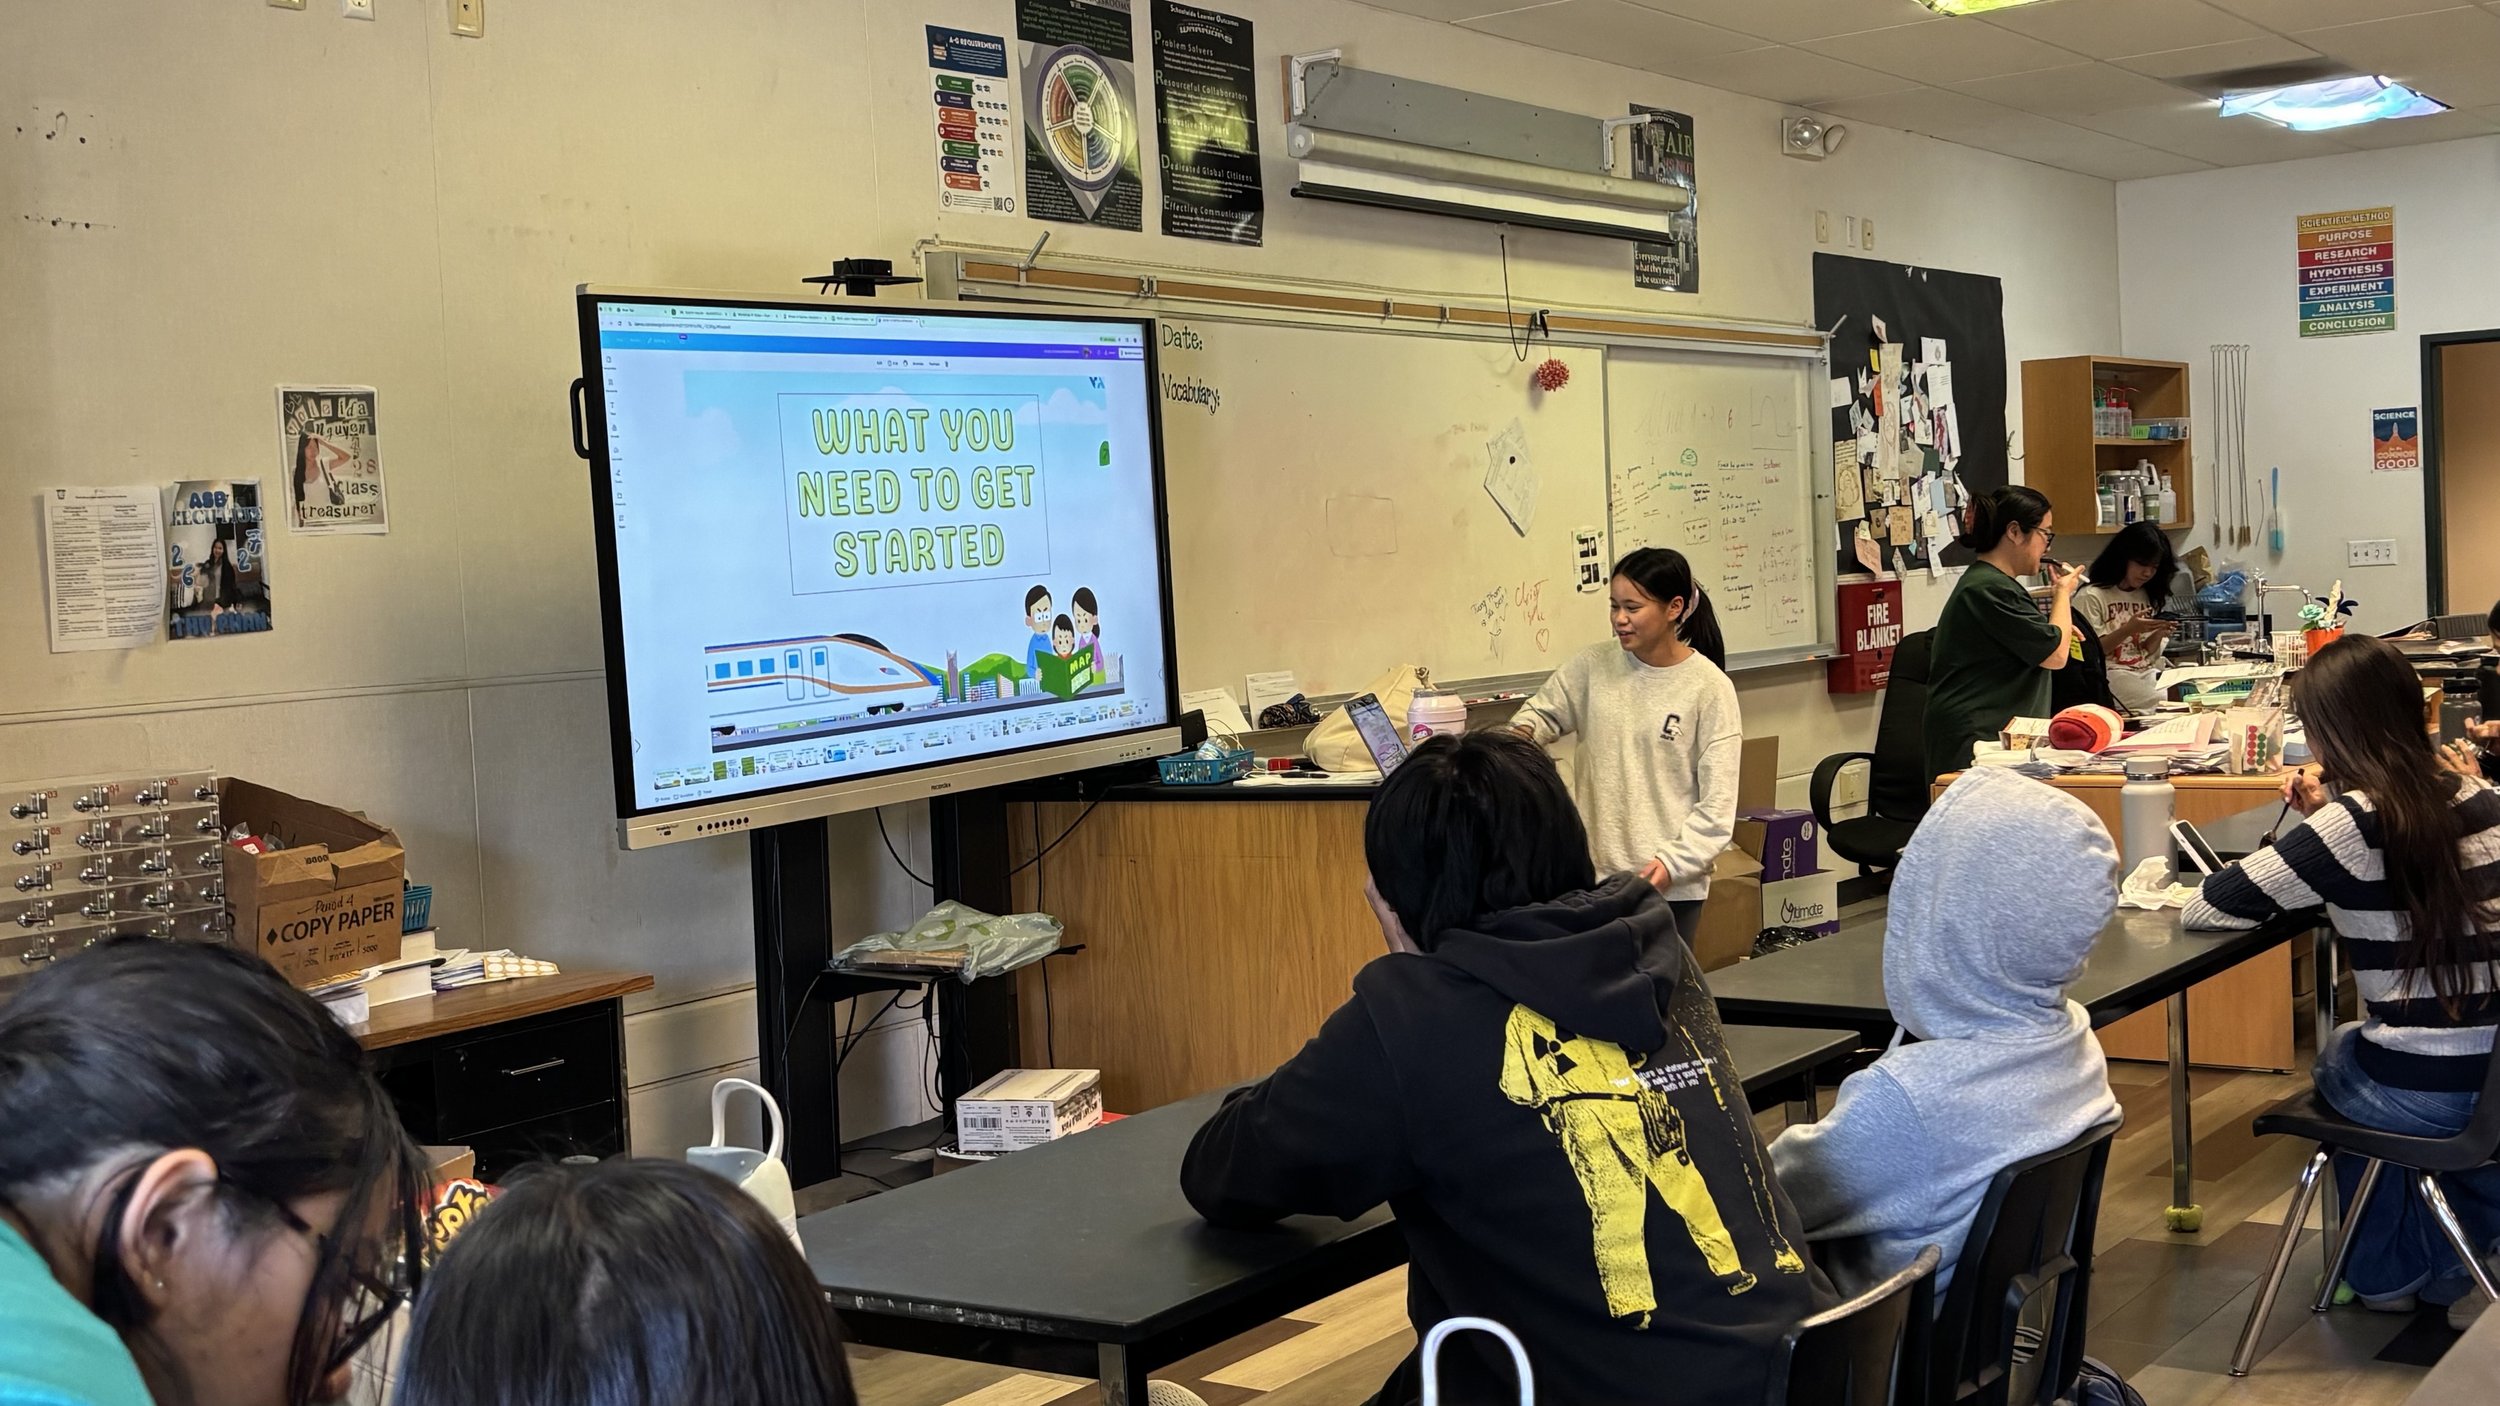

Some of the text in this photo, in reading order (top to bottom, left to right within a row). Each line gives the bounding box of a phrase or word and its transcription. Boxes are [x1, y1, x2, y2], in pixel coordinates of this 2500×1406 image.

[1170, 4, 1239, 27] Schoolwide Learner Outcomes
[1154, 29, 1213, 57] Problem Solvers
[1155, 69, 1248, 102] Resourceful Collaborators
[1161, 153, 1253, 182] Dedicated Global Citizens
[1164, 195, 1198, 214] Effective
[2301, 211, 2390, 228] SCIENTIFIC METHOD
[2318, 229, 2373, 243] PURPOSE
[2314, 246, 2377, 261] RESEARCH
[2309, 263, 2384, 279] HYPOTHESIS
[2309, 281, 2385, 296] EXPERIMENT
[2318, 299, 2375, 313] ANALYSIS
[2309, 316, 2386, 331] CONCLUSION
[1162, 323, 1203, 351] Date:
[1162, 372, 1220, 415] Vocabulary:
[2374, 411, 2416, 421] SCIENCE
[811, 407, 1015, 456] WHAT YOU
[2376, 458, 2417, 469] GOOD
[796, 464, 1036, 517] NEED TO GET
[300, 502, 377, 520] treasurer
[833, 523, 1005, 578] STARTED
[1867, 602, 1889, 627] FIRE
[1856, 623, 1902, 652] BLANKET
[1069, 652, 1092, 675] MAP
[281, 901, 395, 943] COPY PAPER
[1781, 897, 1824, 924] Ultimate
